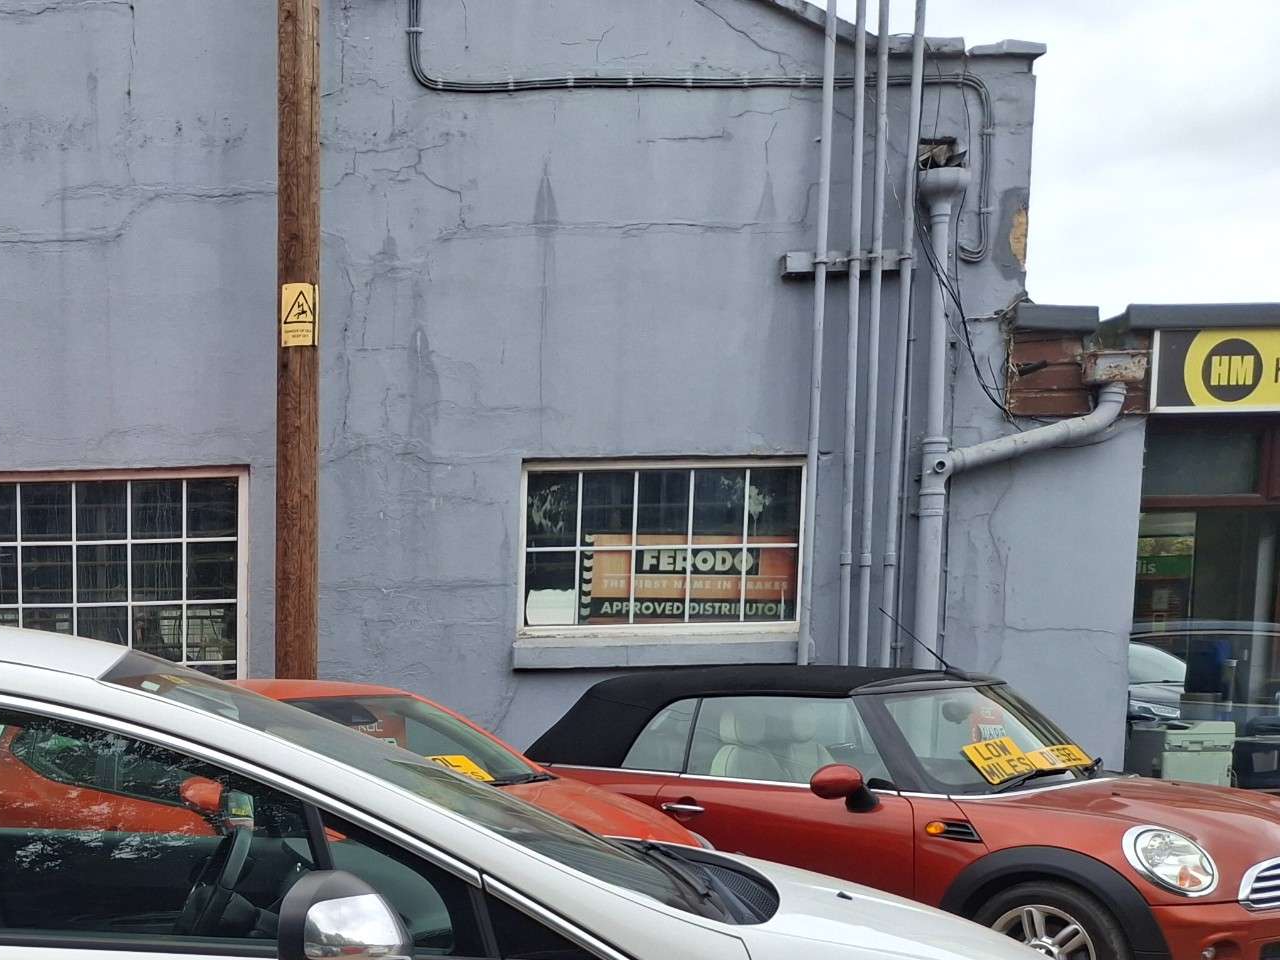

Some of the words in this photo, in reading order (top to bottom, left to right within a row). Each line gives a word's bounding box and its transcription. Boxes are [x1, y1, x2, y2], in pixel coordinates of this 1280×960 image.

[1210, 355, 1255, 386] HM
[642, 550, 754, 572] FERODO
[673, 579, 712, 590] NME
[738, 580, 789, 591] RAKES
[600, 601, 684, 615] APPROVED
[689, 602, 787, 616] DISTRIUTOR
[974, 740, 1012, 761] LOW
[981, 757, 1032, 780] MILES
